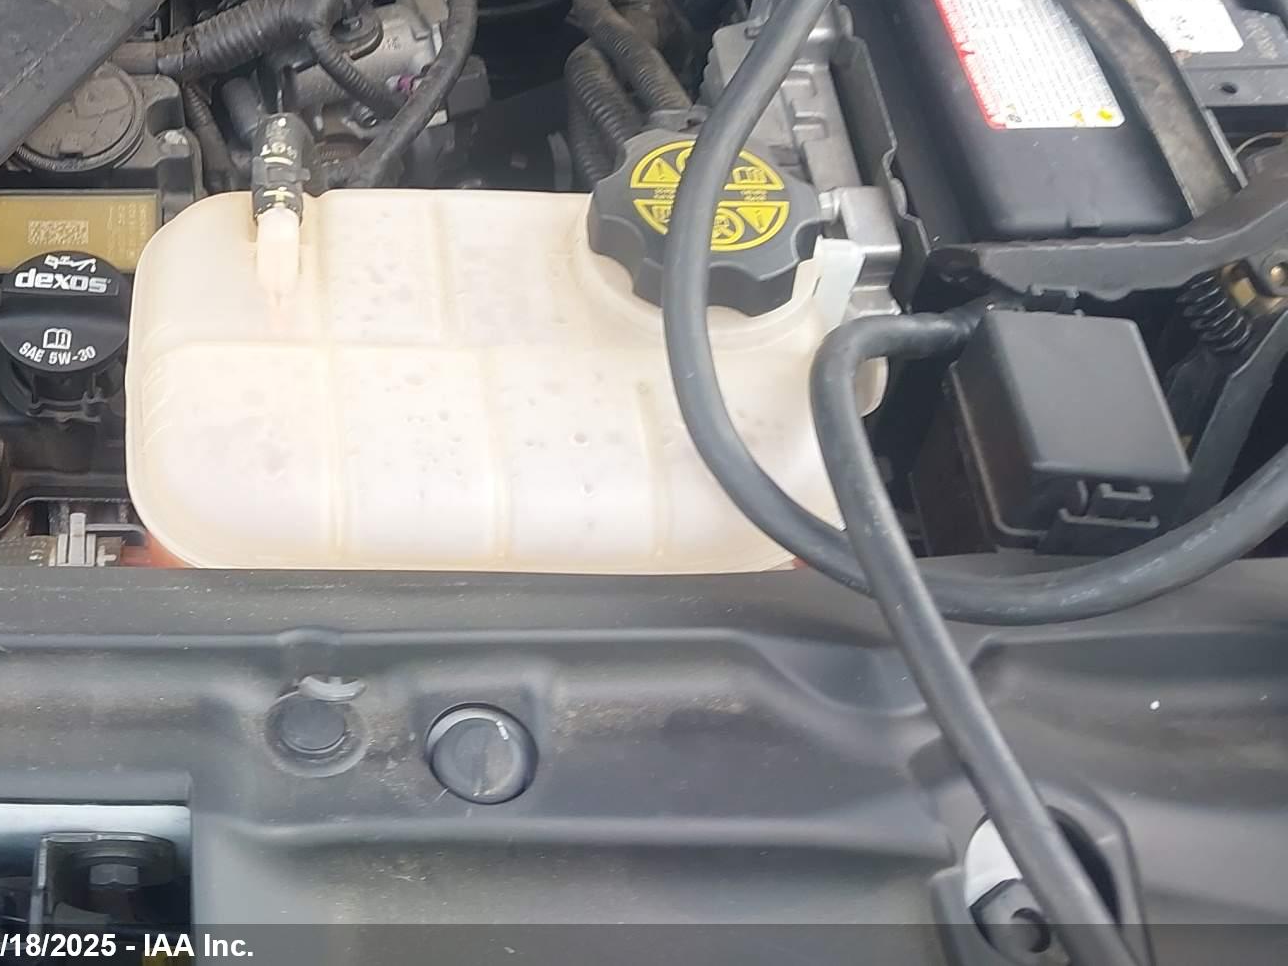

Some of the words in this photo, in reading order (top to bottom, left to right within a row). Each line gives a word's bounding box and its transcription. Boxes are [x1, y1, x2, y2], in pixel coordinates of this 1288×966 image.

[14, 268, 108, 293] dexos
[19, 341, 46, 363] SAE
[48, 345, 96, 366] 5W-30
